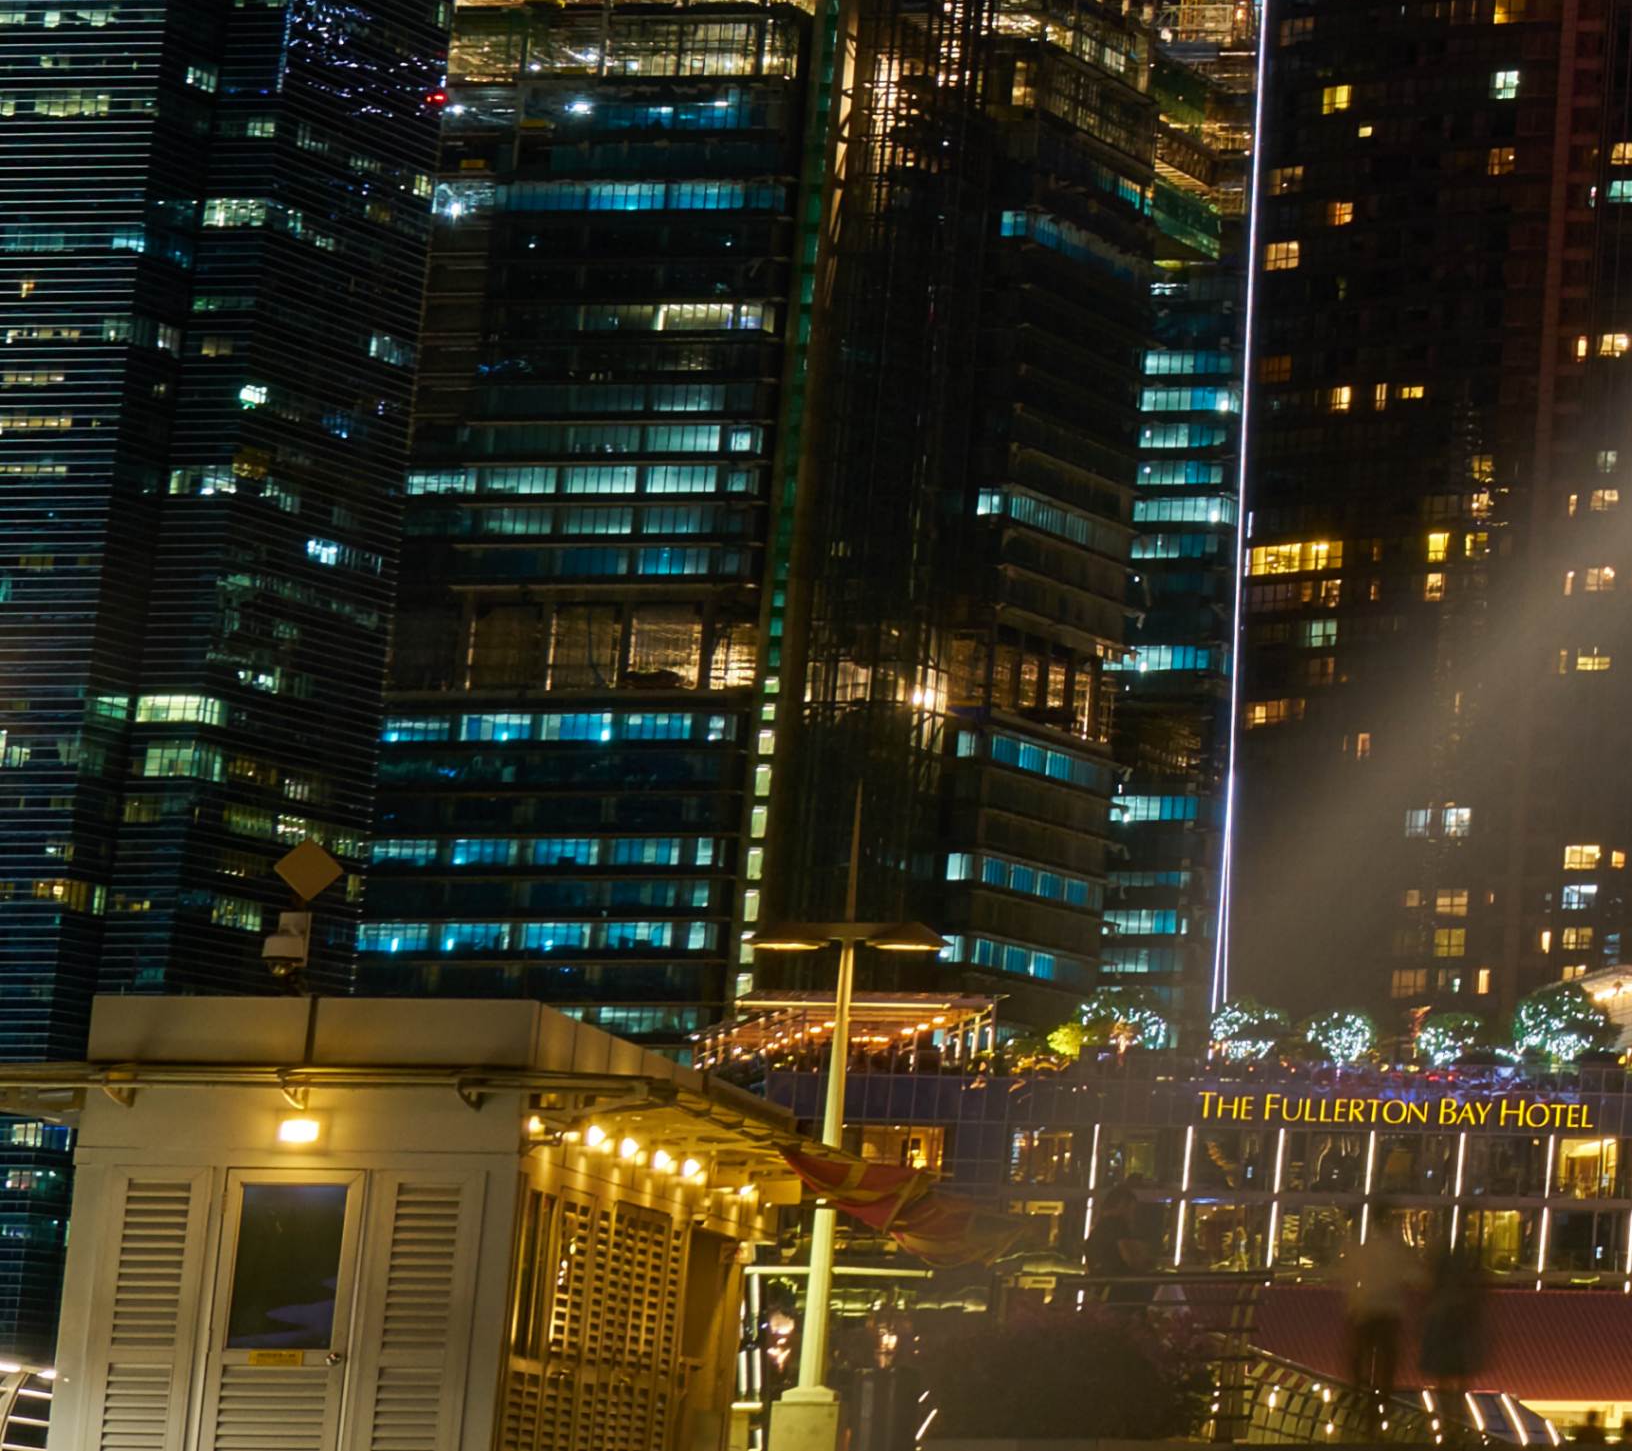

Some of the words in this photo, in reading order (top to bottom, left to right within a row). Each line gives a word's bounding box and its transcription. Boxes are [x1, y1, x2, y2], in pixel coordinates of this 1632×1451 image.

[1198, 1091, 1254, 1121] THE
[1263, 1093, 1429, 1125] FULLERTON
[1438, 1097, 1494, 1126] BAY
[1500, 1099, 1594, 1129] HOTEL
